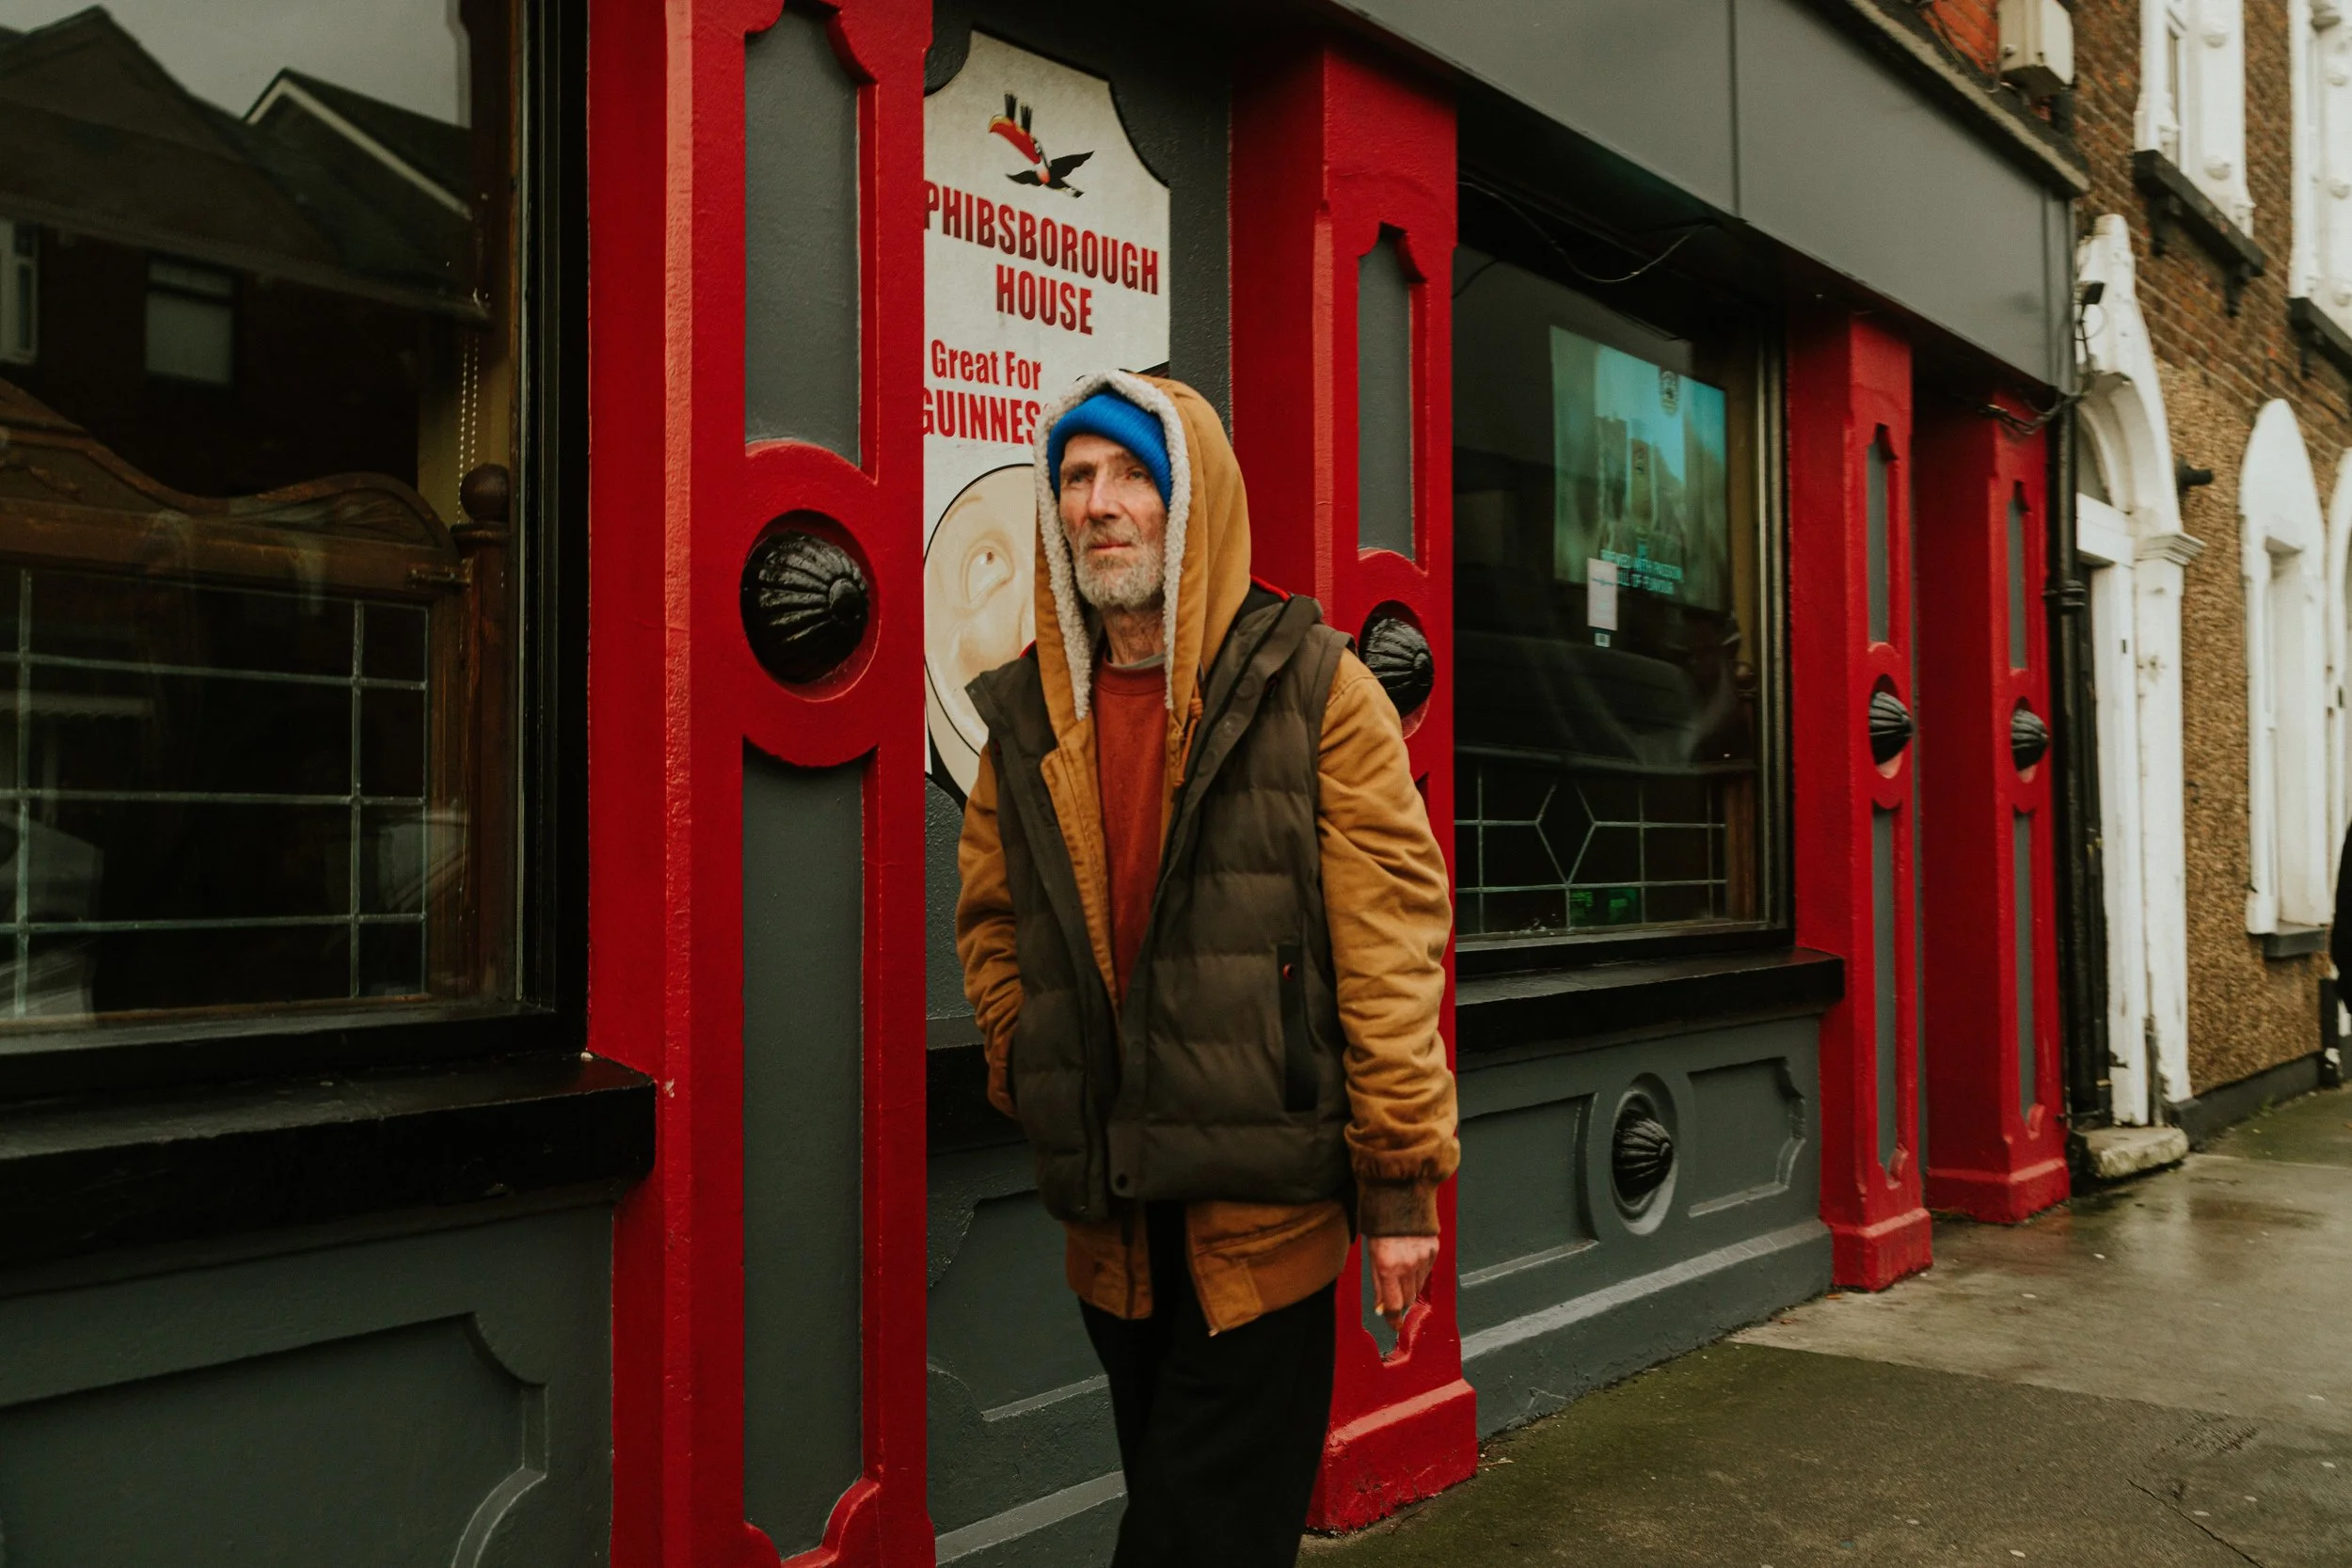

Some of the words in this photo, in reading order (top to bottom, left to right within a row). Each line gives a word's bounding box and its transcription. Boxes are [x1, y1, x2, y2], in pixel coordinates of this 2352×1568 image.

[924, 180, 1158, 295] PHIBSBOROUGH
[996, 264, 1092, 335] HOUSE
[931, 339, 999, 386] Great
[1005, 351, 1041, 390] For
[923, 387, 1047, 446] GUINNES
